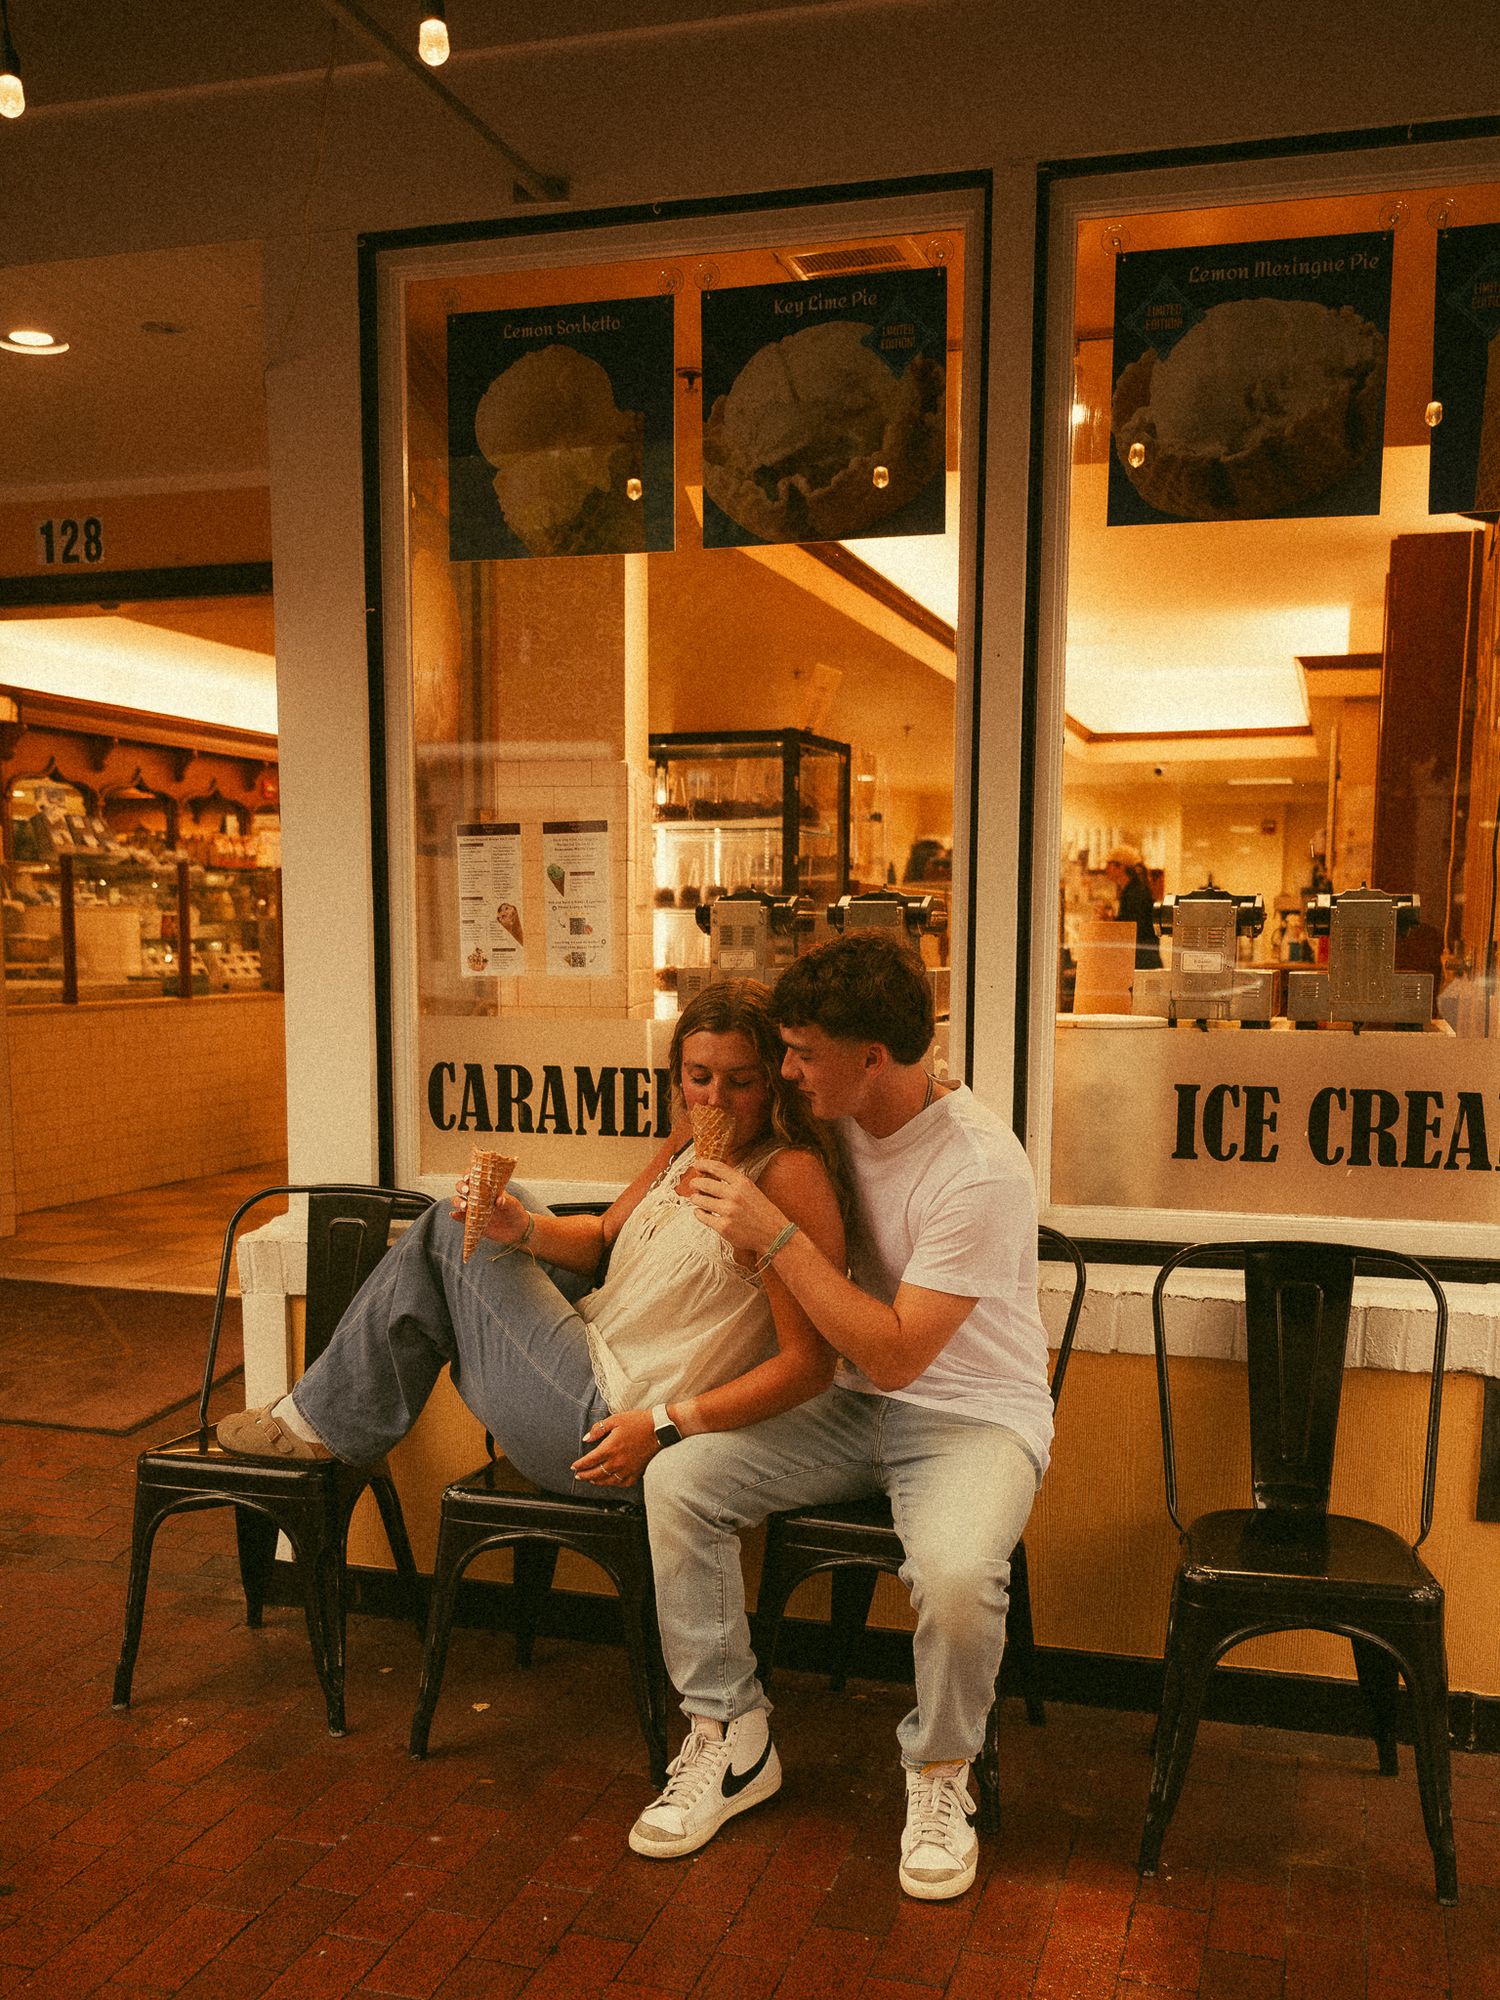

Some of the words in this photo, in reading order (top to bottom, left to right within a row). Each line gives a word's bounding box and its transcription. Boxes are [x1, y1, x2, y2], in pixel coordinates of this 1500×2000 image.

[1188, 265, 1249, 283] Lemon
[1254, 256, 1345, 279] Meringue
[1350, 252, 1380, 270] Pie
[773, 299, 804, 317] Key
[808, 293, 848, 311] Lime
[852, 288, 878, 306] Pie
[1147, 303, 1183, 317] LIMITED
[503, 324, 553, 339] Lemon
[556, 315, 621, 335] Sorbetto
[882, 323, 915, 337] LIMITED
[40, 517, 102, 564] 128
[1171, 1083, 1281, 1163] ICE
[1307, 1086, 1500, 1172] CREA
